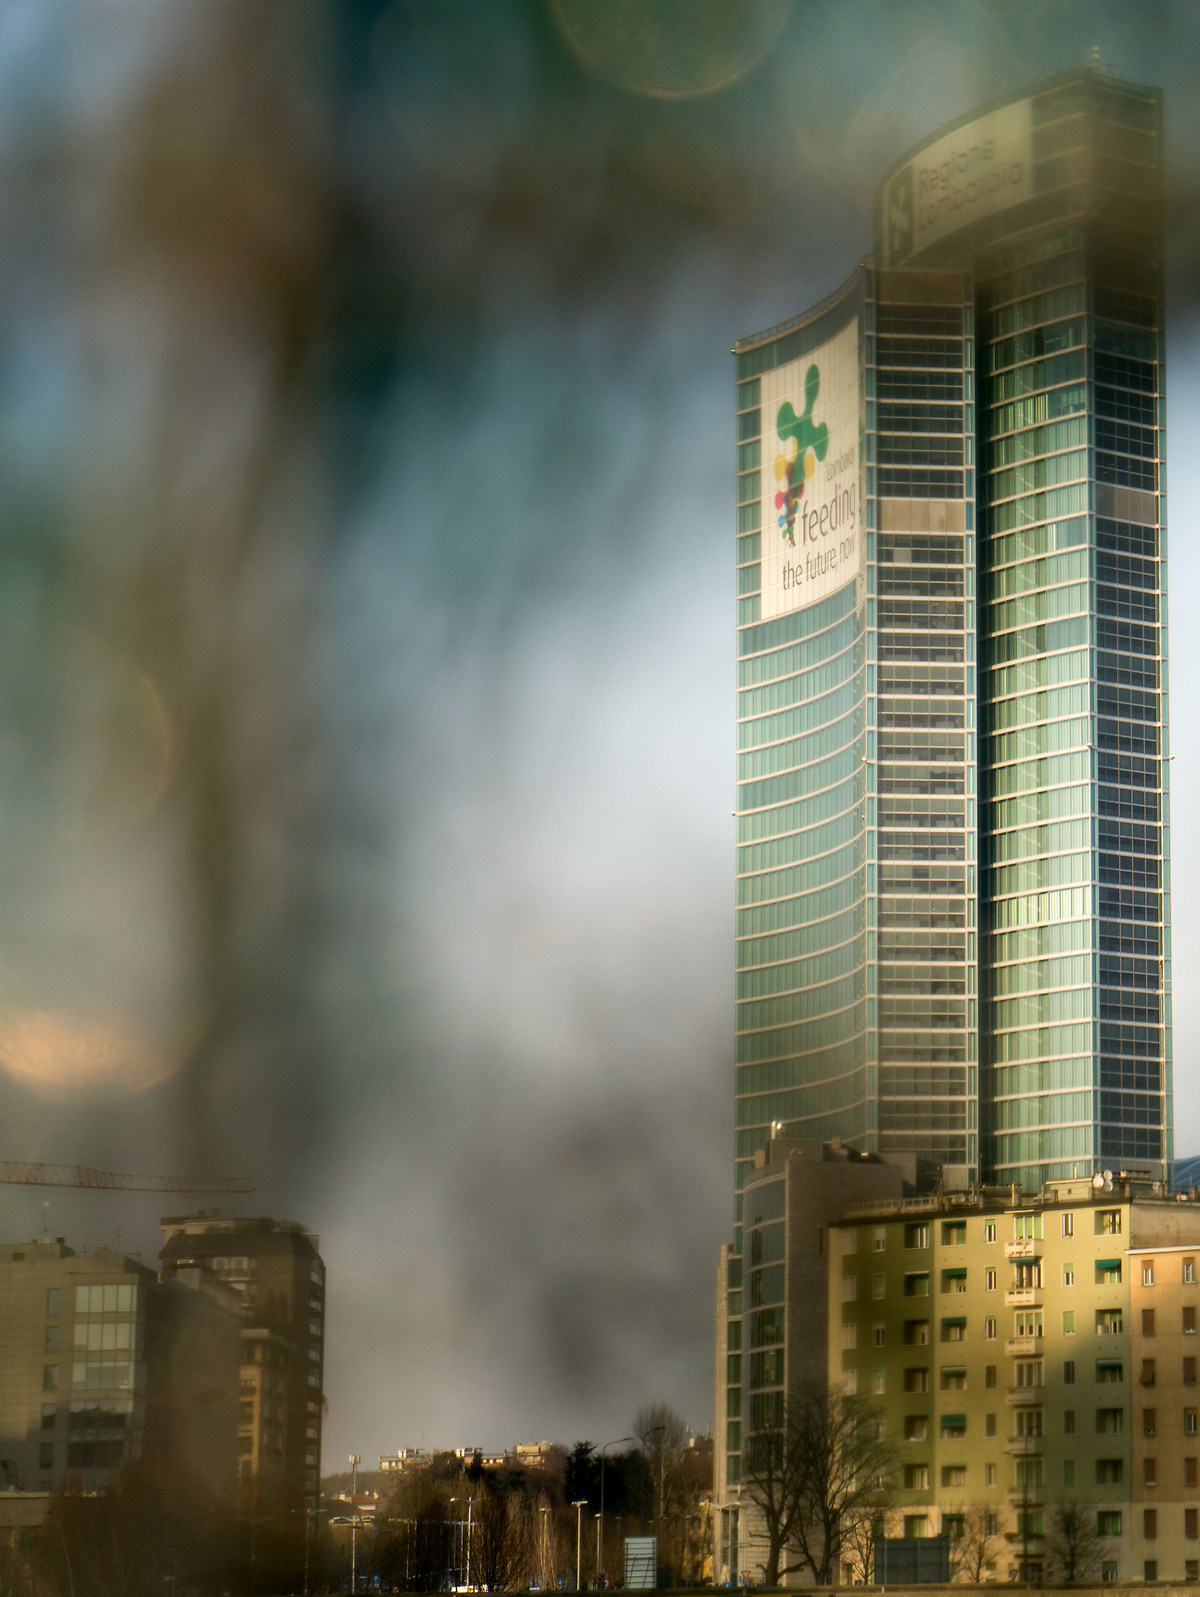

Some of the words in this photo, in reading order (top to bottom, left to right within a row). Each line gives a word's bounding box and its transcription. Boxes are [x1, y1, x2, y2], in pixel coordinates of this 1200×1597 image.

[802, 482, 856, 546] feeding
[782, 560, 803, 591] the
[839, 533, 856, 565] now
